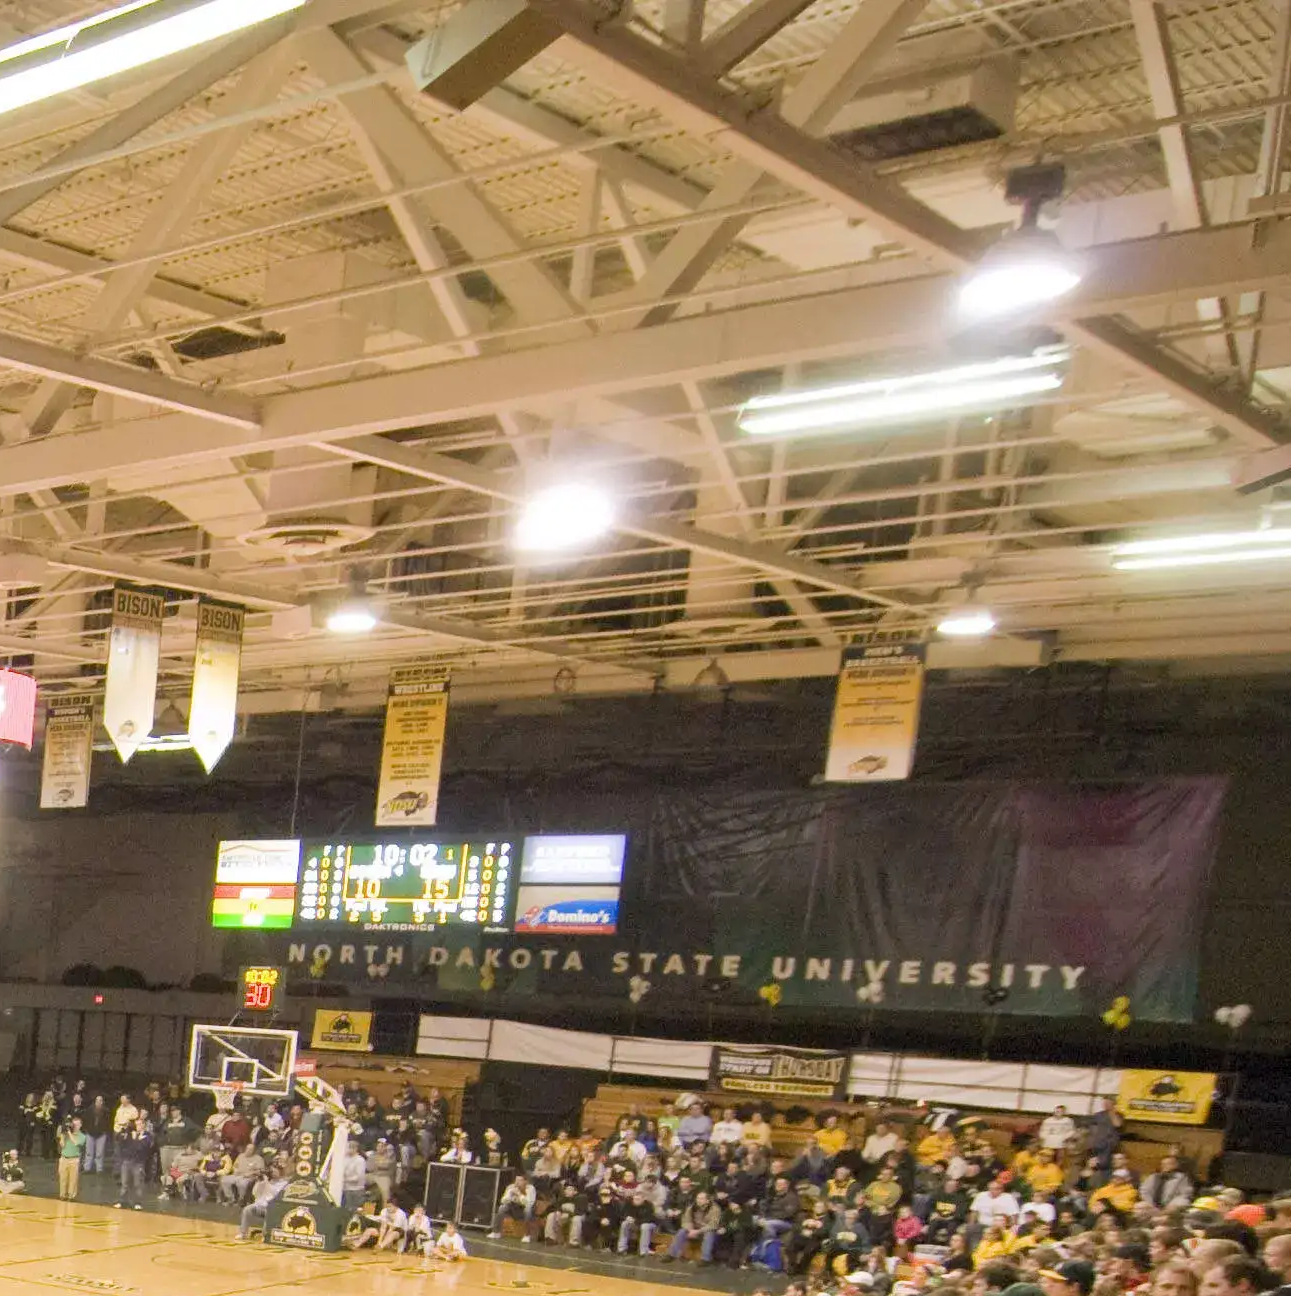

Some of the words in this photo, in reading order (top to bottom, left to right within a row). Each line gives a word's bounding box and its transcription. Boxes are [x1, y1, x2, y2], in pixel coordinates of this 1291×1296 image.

[118, 593, 163, 618] BISON
[201, 607, 242, 632] BISON
[373, 843, 439, 867] 10:02
[355, 878, 381, 899] 10
[423, 878, 449, 899] 15
[364, 923, 435, 932] DAKTRONICS
[548, 909, 610, 923] Domino's
[288, 942, 403, 966] NORTH
[429, 945, 584, 972] DAKOTA
[611, 950, 742, 978] STATE
[771, 955, 1087, 990] UNIVERSITY
[244, 983, 272, 1007] 30
